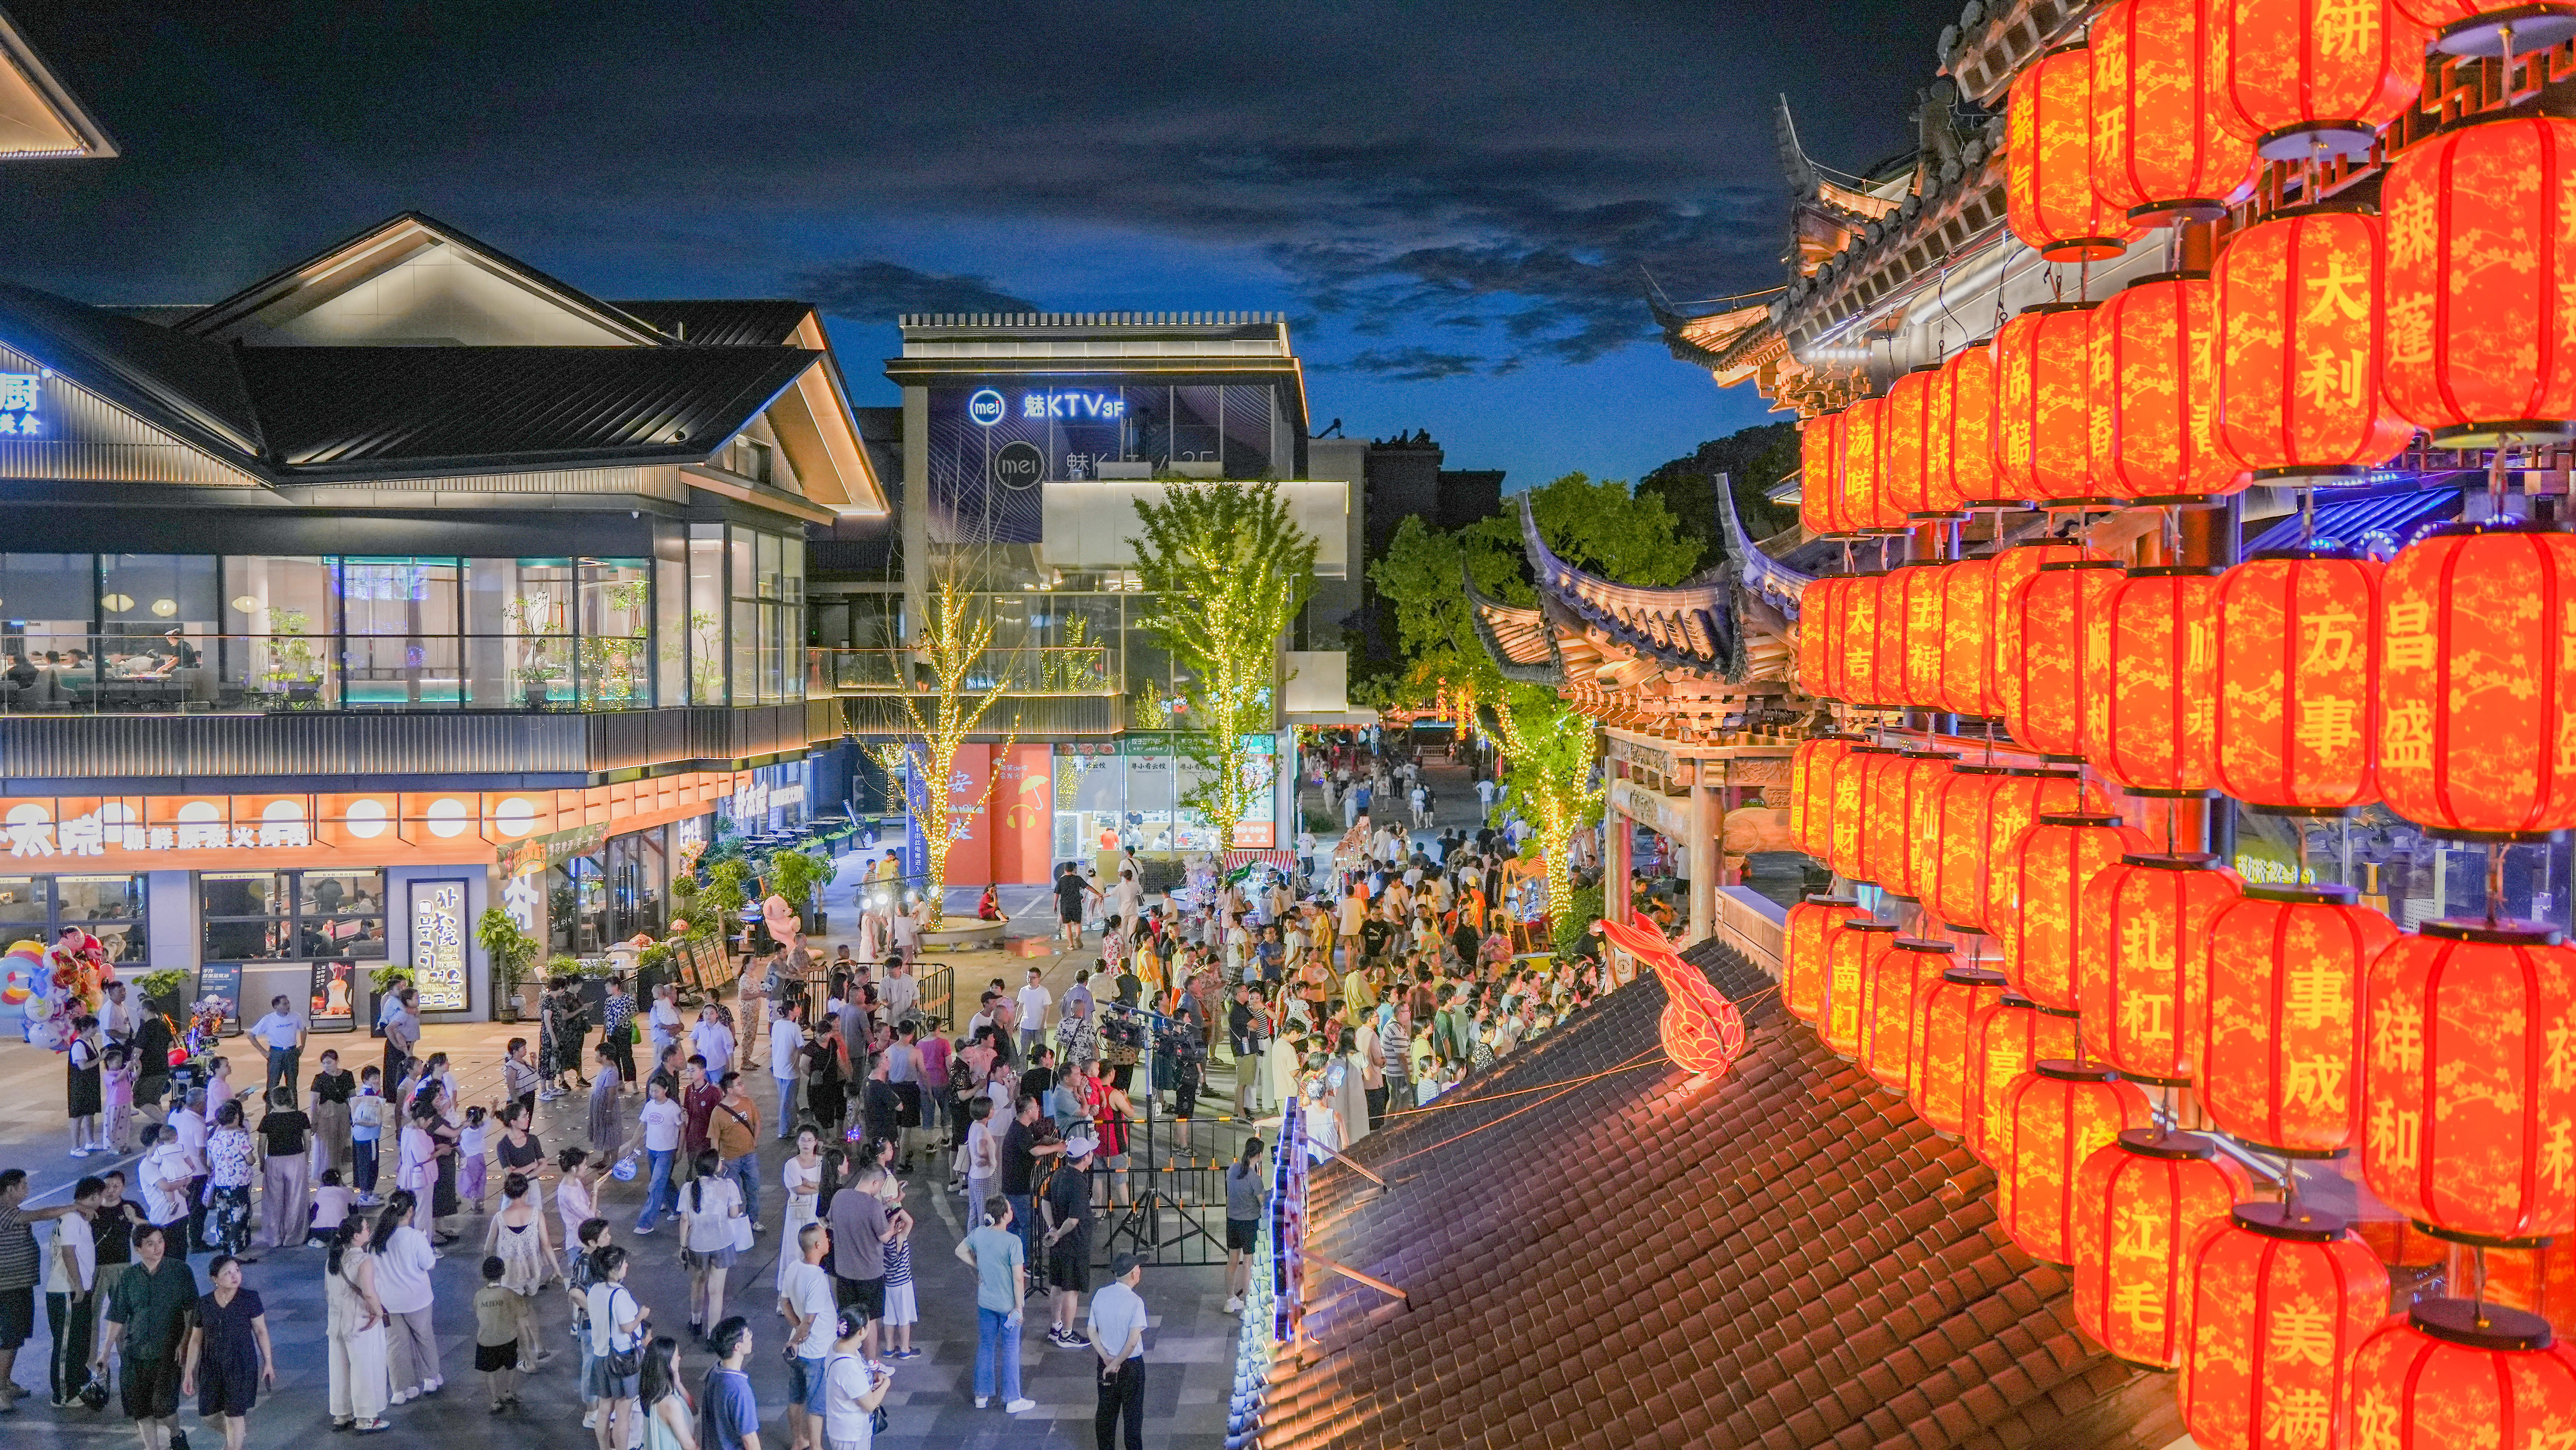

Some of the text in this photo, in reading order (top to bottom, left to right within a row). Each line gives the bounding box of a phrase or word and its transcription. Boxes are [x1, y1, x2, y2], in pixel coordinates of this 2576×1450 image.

[2011, 98, 2034, 204] 紫气
[2094, 34, 2126, 164] 花开
[2299, 263, 2366, 408] 大利
[2388, 192, 2437, 368] 辣蓬
[975, 400, 999, 415] mei
[1002, 458, 1036, 474] mei
[1937, 381, 1951, 469] 东来
[1846, 603, 1874, 677] 大吉
[2087, 621, 2109, 741] 顺利
[2296, 614, 2361, 758] 万事
[2381, 600, 2434, 769] 昌盛
[1791, 767, 1804, 832] 团圆
[1833, 781, 1859, 855] 发财
[1921, 805, 1939, 894] 山粉
[1832, 962, 1859, 1035] 南门
[2121, 917, 2175, 1041] 扎杠
[2283, 967, 2348, 1114] 事成
[2370, 999, 2423, 1171] 祥和
[2114, 1207, 2165, 1332] 江毛
[2265, 1301, 2333, 1450] 美满
